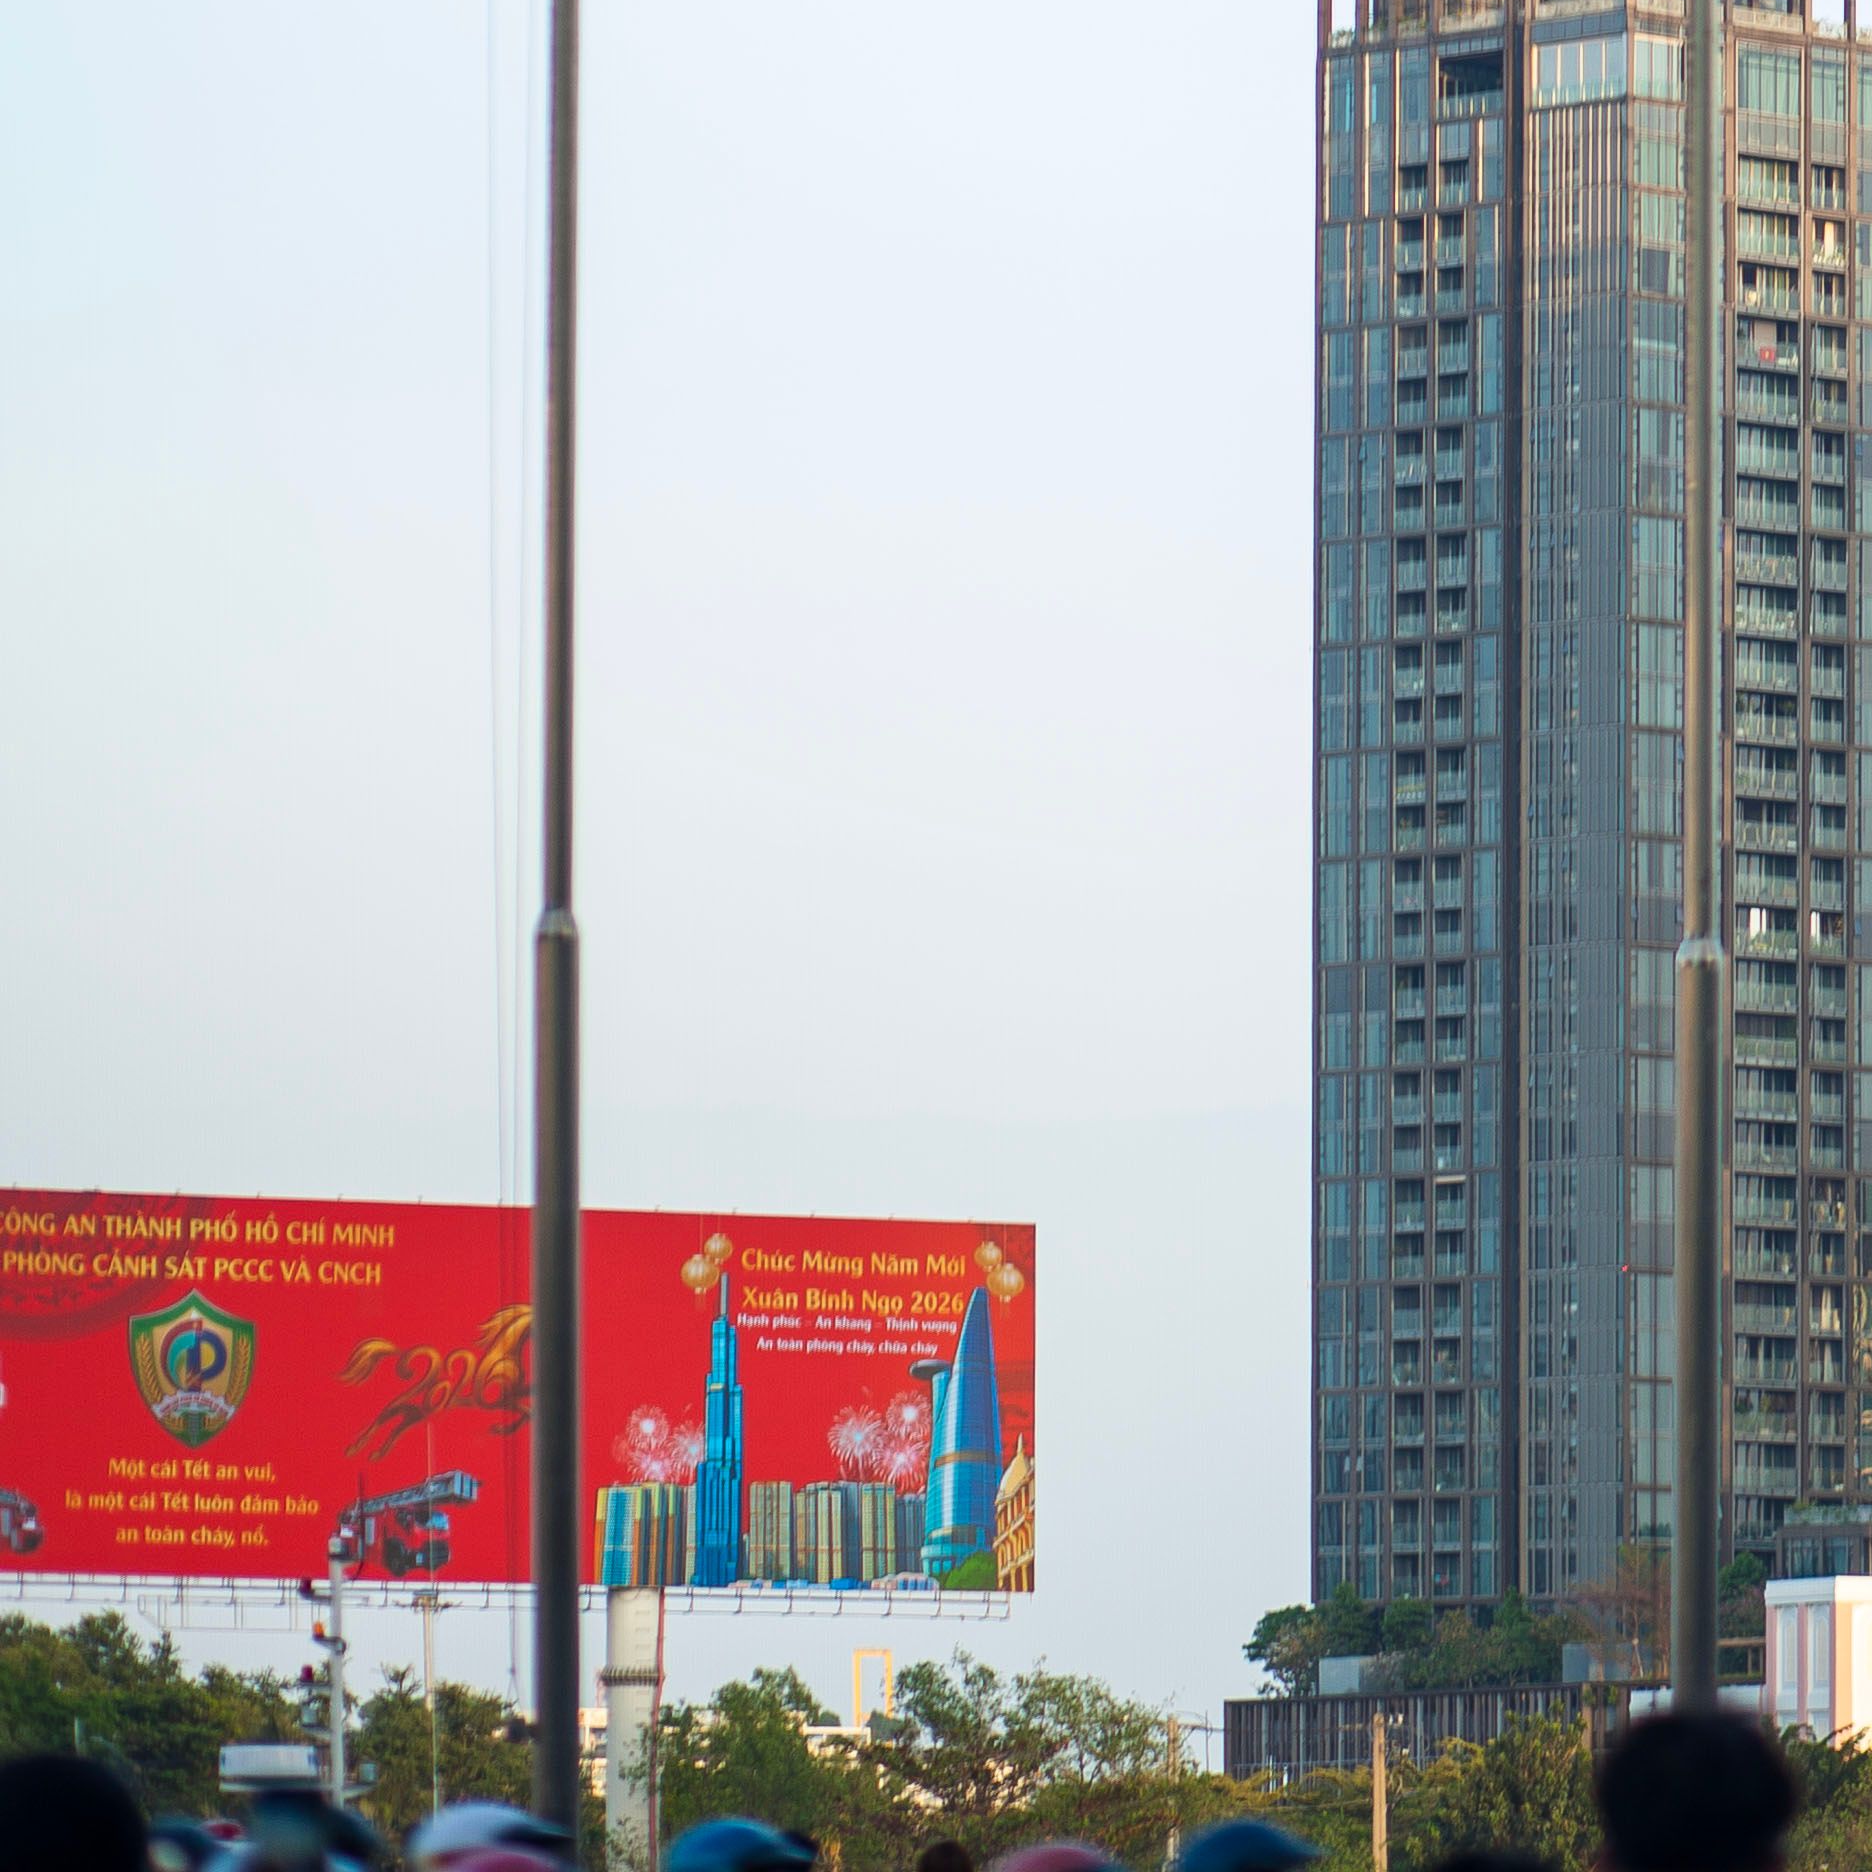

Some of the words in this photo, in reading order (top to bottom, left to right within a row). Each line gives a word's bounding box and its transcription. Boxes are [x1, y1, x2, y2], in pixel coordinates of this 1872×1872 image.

[63, 1213, 96, 1236] AN
[103, 1210, 181, 1239] THÀNH
[190, 1209, 237, 1243] PHỐ
[245, 1211, 280, 1244] HỒ
[286, 1216, 325, 1246] CHÍ
[332, 1223, 395, 1247] MINH
[3, 1247, 84, 1276] PHÒNG
[93, 1248, 157, 1277] CẢNH
[164, 1249, 206, 1279] SÁT
[214, 1257, 273, 1282] PCCC
[280, 1255, 311, 1283] VÀ
[318, 1261, 382, 1285] CNCH
[741, 1247, 795, 1272] Chúc
[802, 1250, 864, 1277] Mừng
[871, 1252, 918, 1275] Năm
[926, 1254, 966, 1277] Mới
[742, 1286, 799, 1310] Xuân
[806, 1288, 854, 1311] Bính
[862, 1289, 903, 1316] Ngọ
[910, 1291, 964, 1314] 2026
[815, 1315, 832, 1329] An
[835, 1316, 871, 1333] khang
[756, 1336, 772, 1351] An
[108, 1457, 145, 1481] Một
[151, 1459, 177, 1478] cái
[182, 1458, 210, 1479] Tết
[216, 1463, 238, 1479] an
[245, 1462, 276, 1483] vui,
[65, 1489, 82, 1509] là
[89, 1491, 123, 1513] một
[129, 1493, 155, 1511] cái
[161, 1490, 189, 1511] Tết
[195, 1492, 234, 1512] luôn
[116, 1528, 138, 1543] an
[144, 1525, 184, 1544] toàn
